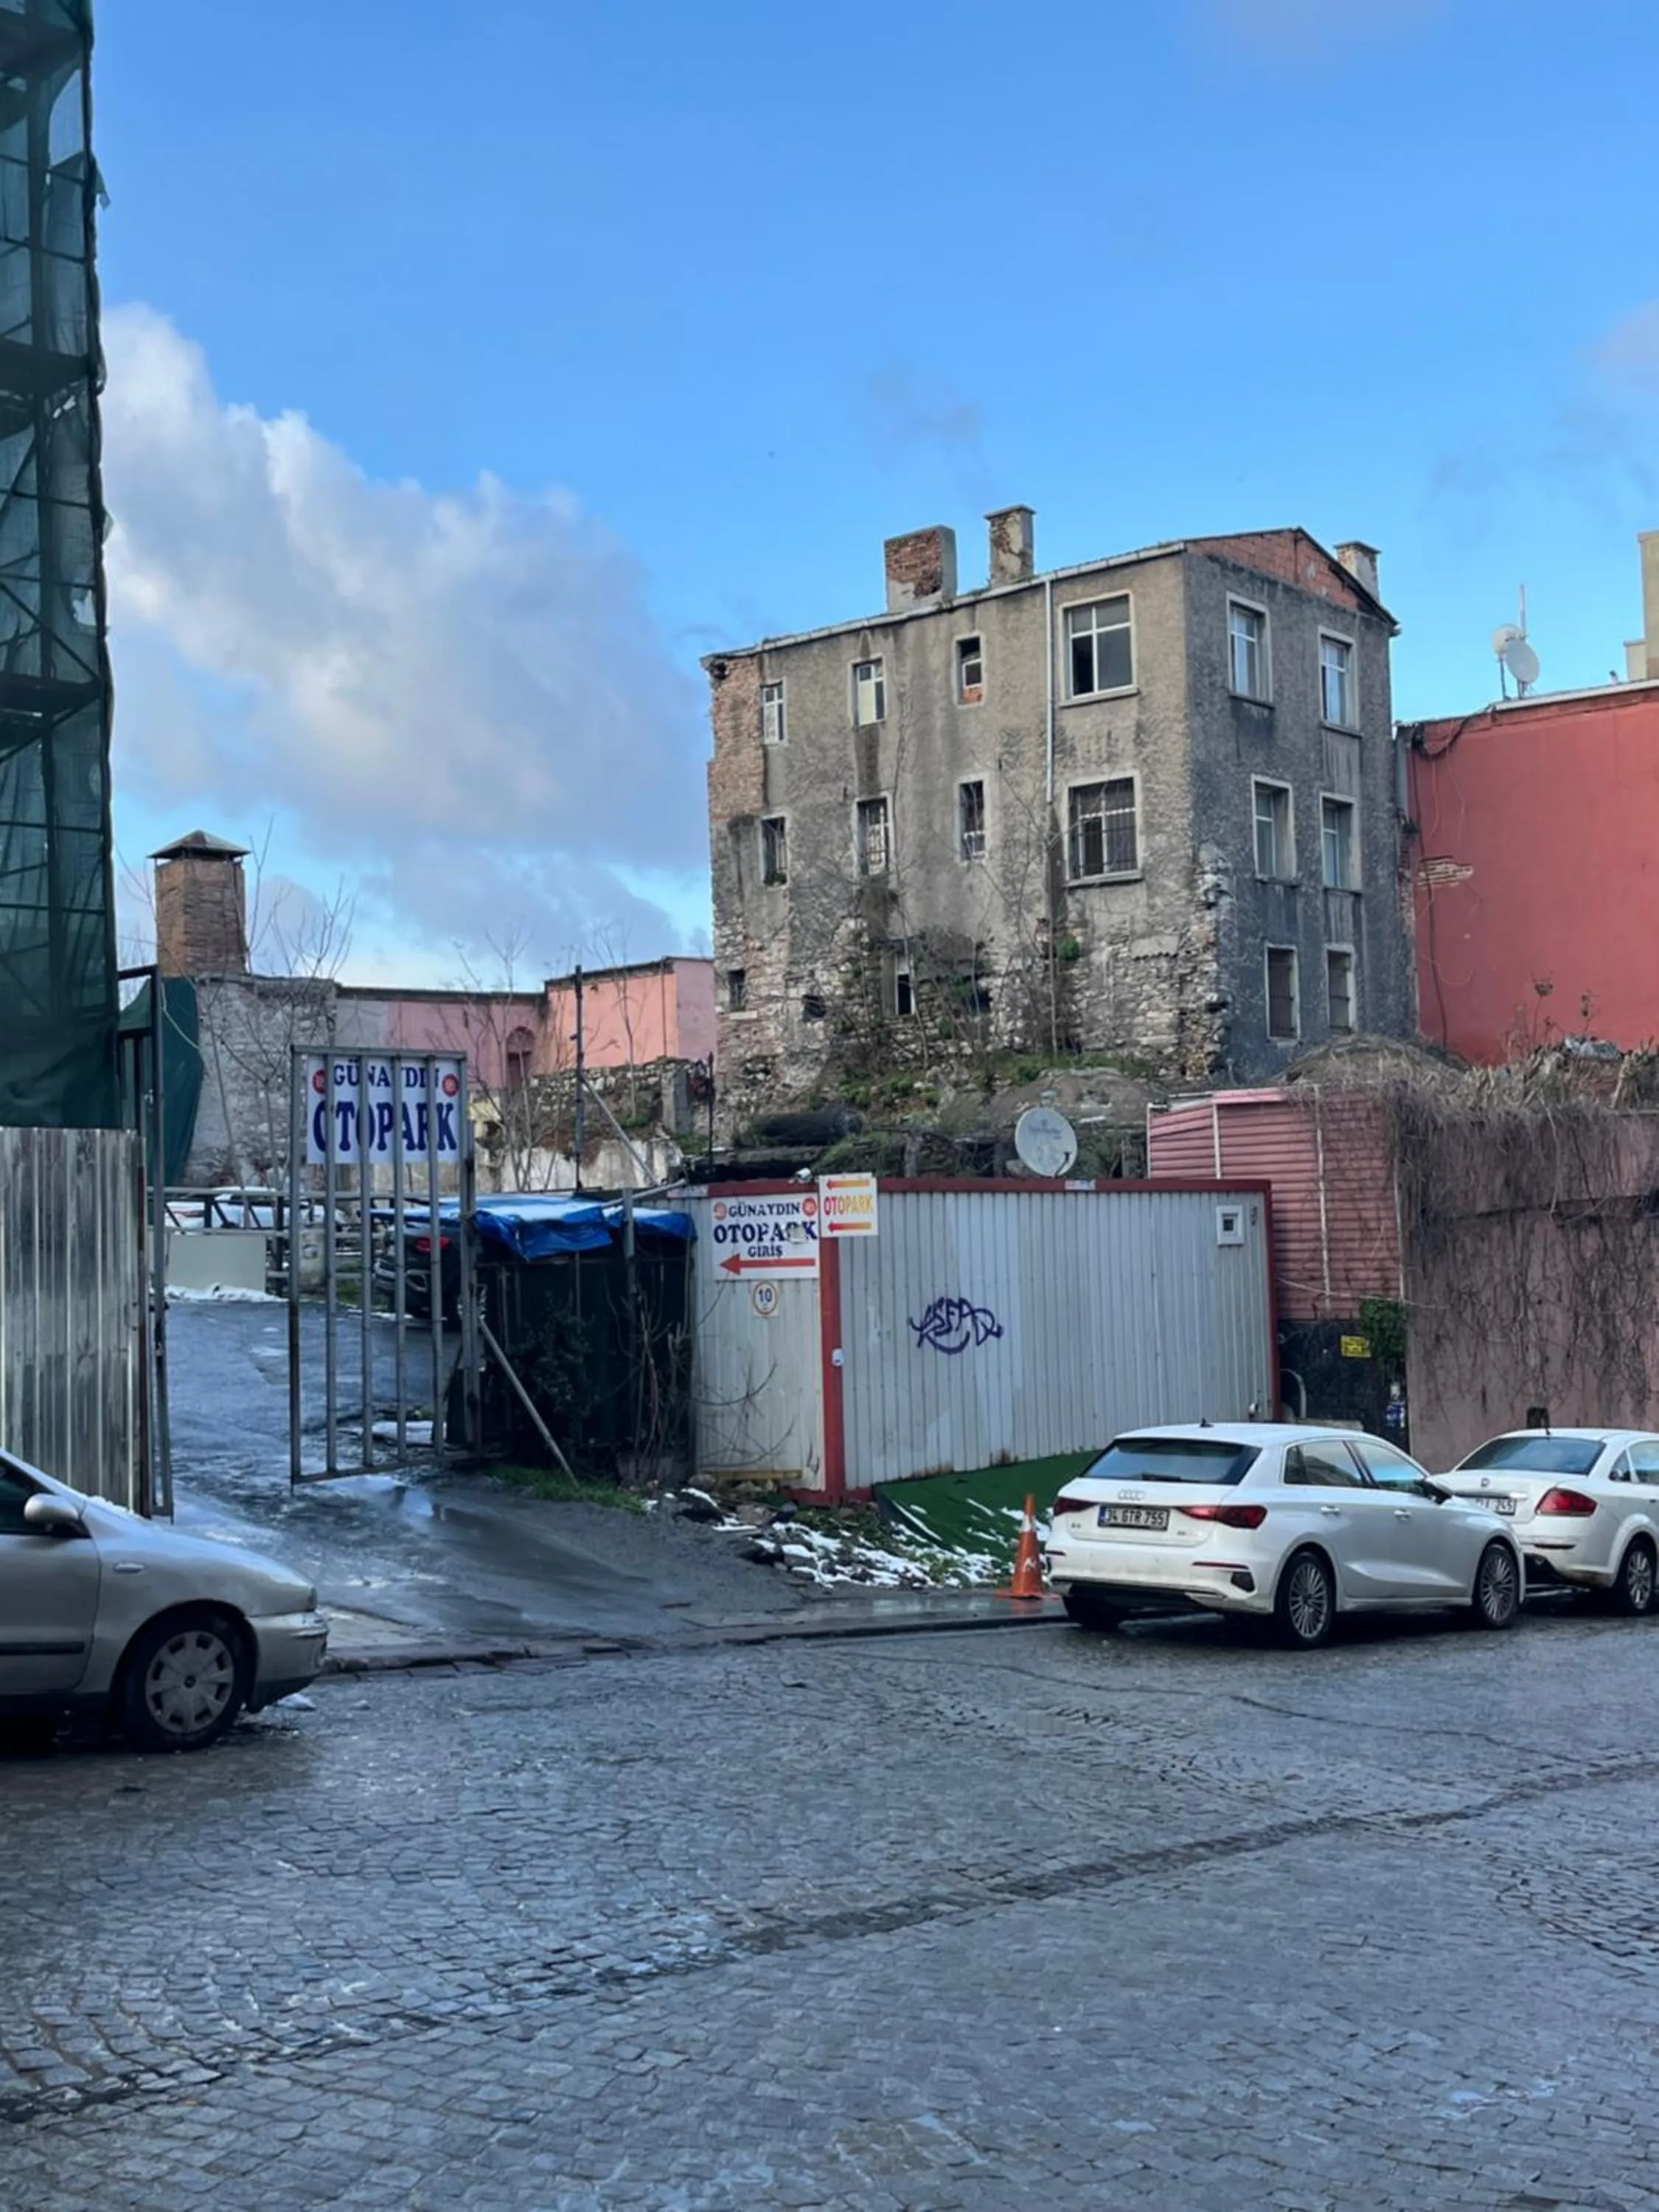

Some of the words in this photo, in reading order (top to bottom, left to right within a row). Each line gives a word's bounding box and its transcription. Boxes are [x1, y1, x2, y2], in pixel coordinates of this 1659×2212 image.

[728, 1202, 800, 1217] GÜNAYDIN
[824, 1195, 874, 1216] OTOPARK
[759, 1288, 773, 1303] 10
